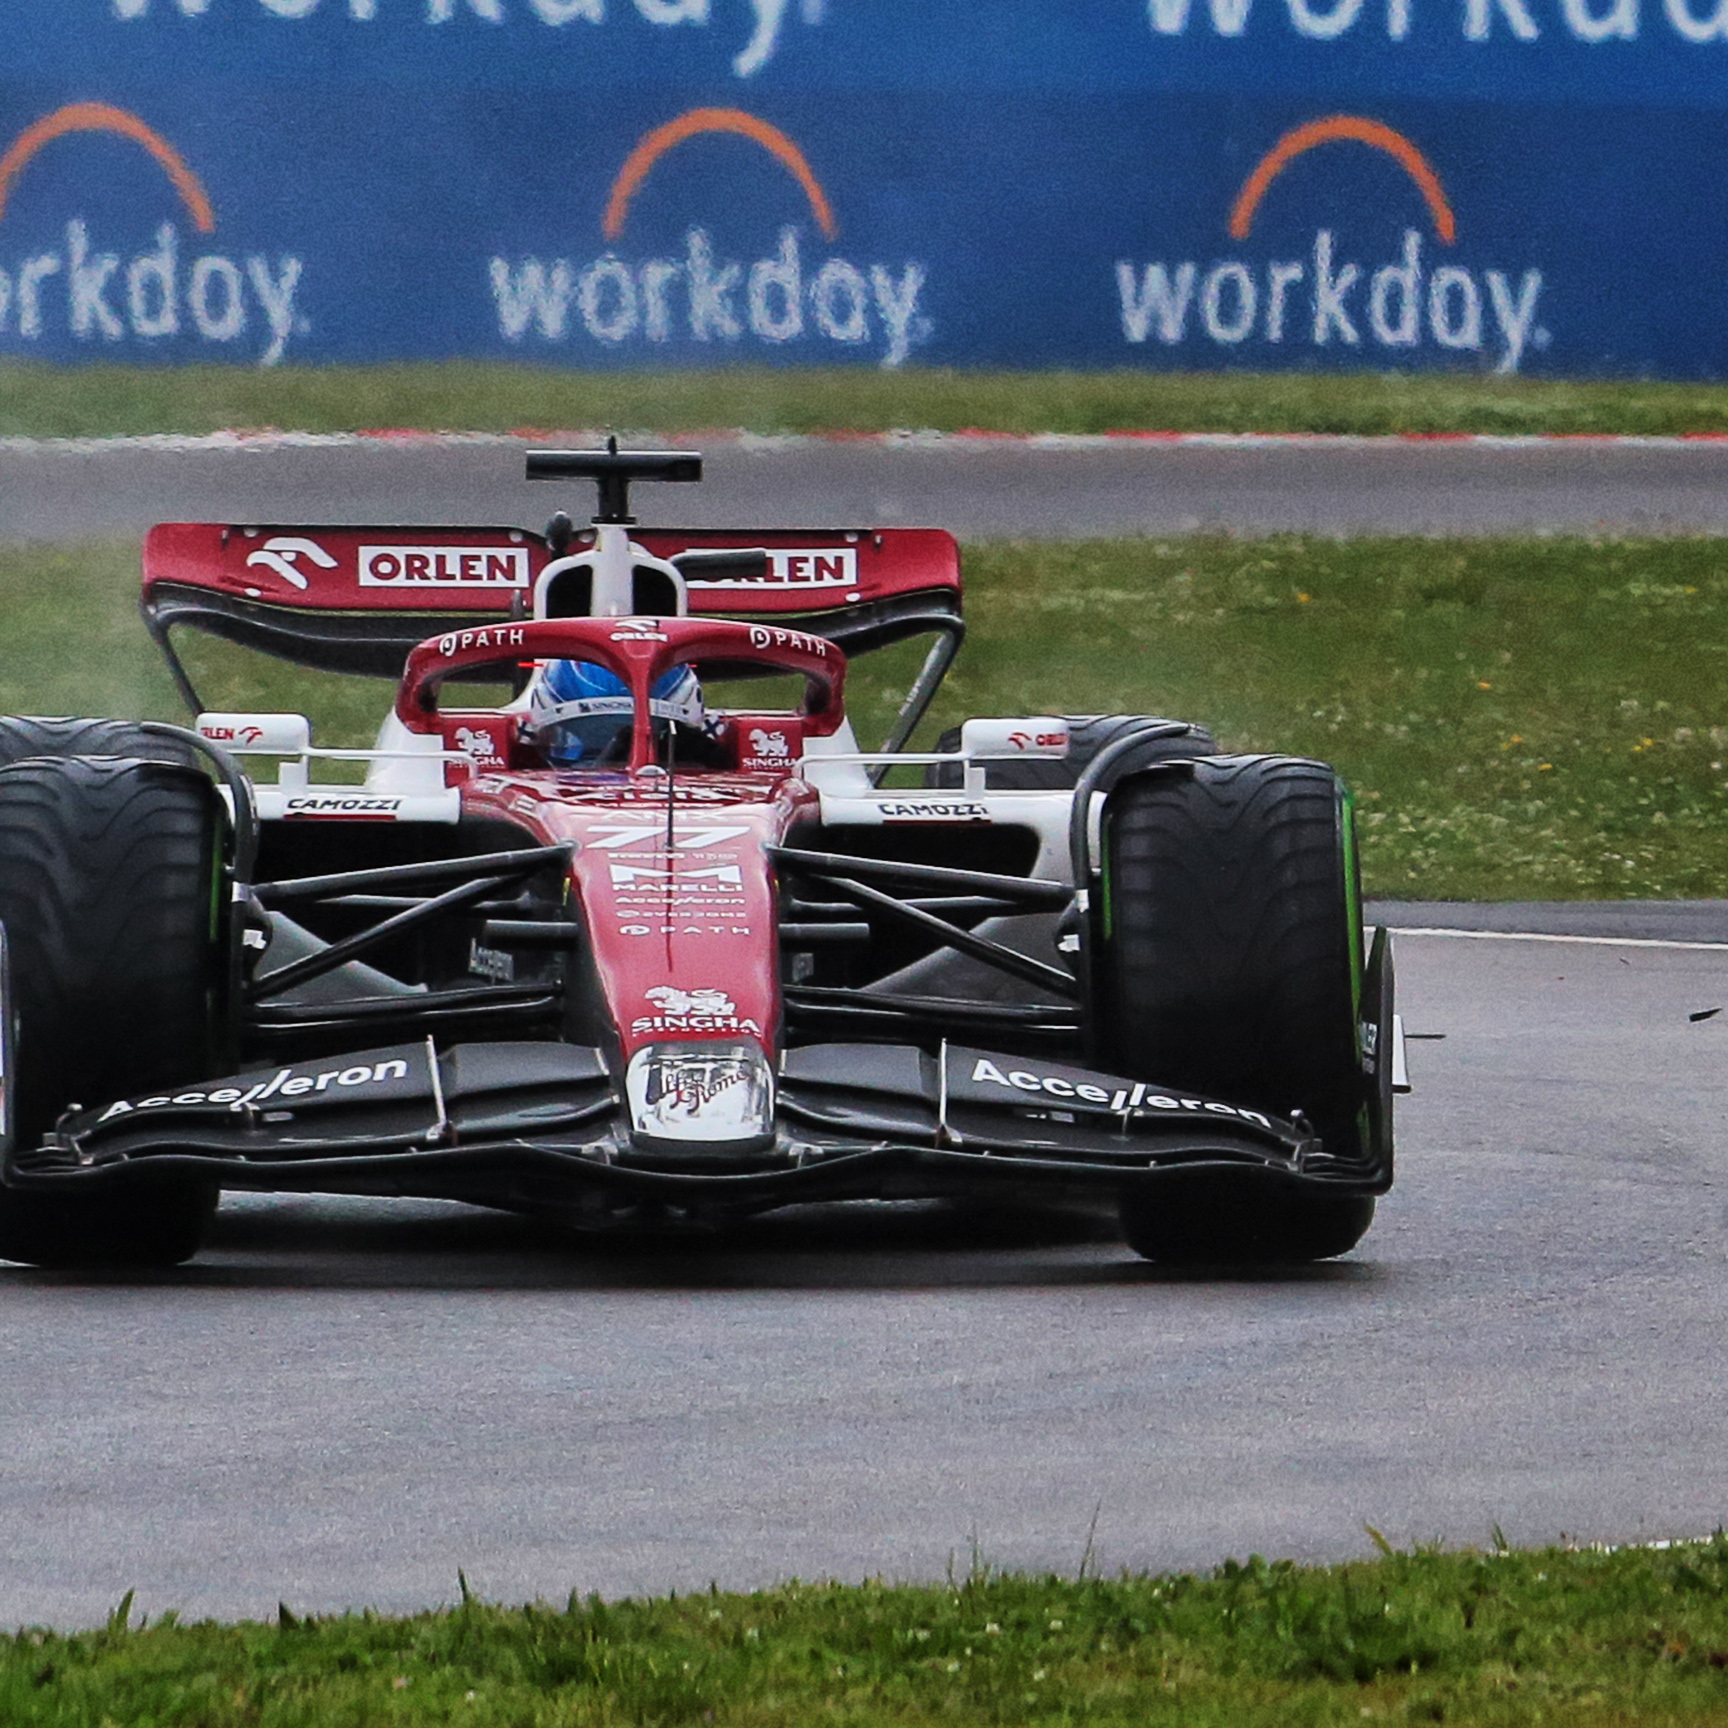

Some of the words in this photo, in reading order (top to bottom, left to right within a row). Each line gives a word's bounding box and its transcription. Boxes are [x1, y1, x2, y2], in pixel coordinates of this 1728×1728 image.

[0, 219, 303, 369] rkday
[489, 225, 925, 371] workday
[1115, 229, 1544, 375] workday
[369, 553, 517, 581] ORLEN
[462, 629, 524, 649] PATH
[774, 629, 827, 657] PATH
[287, 798, 402, 810] CAMOZZI
[878, 803, 989, 815] CAMOZZI
[586, 825, 750, 849] 77
[612, 883, 743, 892] MARELLI
[660, 925, 751, 936] PATH
[631, 1016, 761, 1033] SINGHA
[97, 1058, 408, 1122] Accelleron
[971, 1058, 1272, 1129] Accelleron
